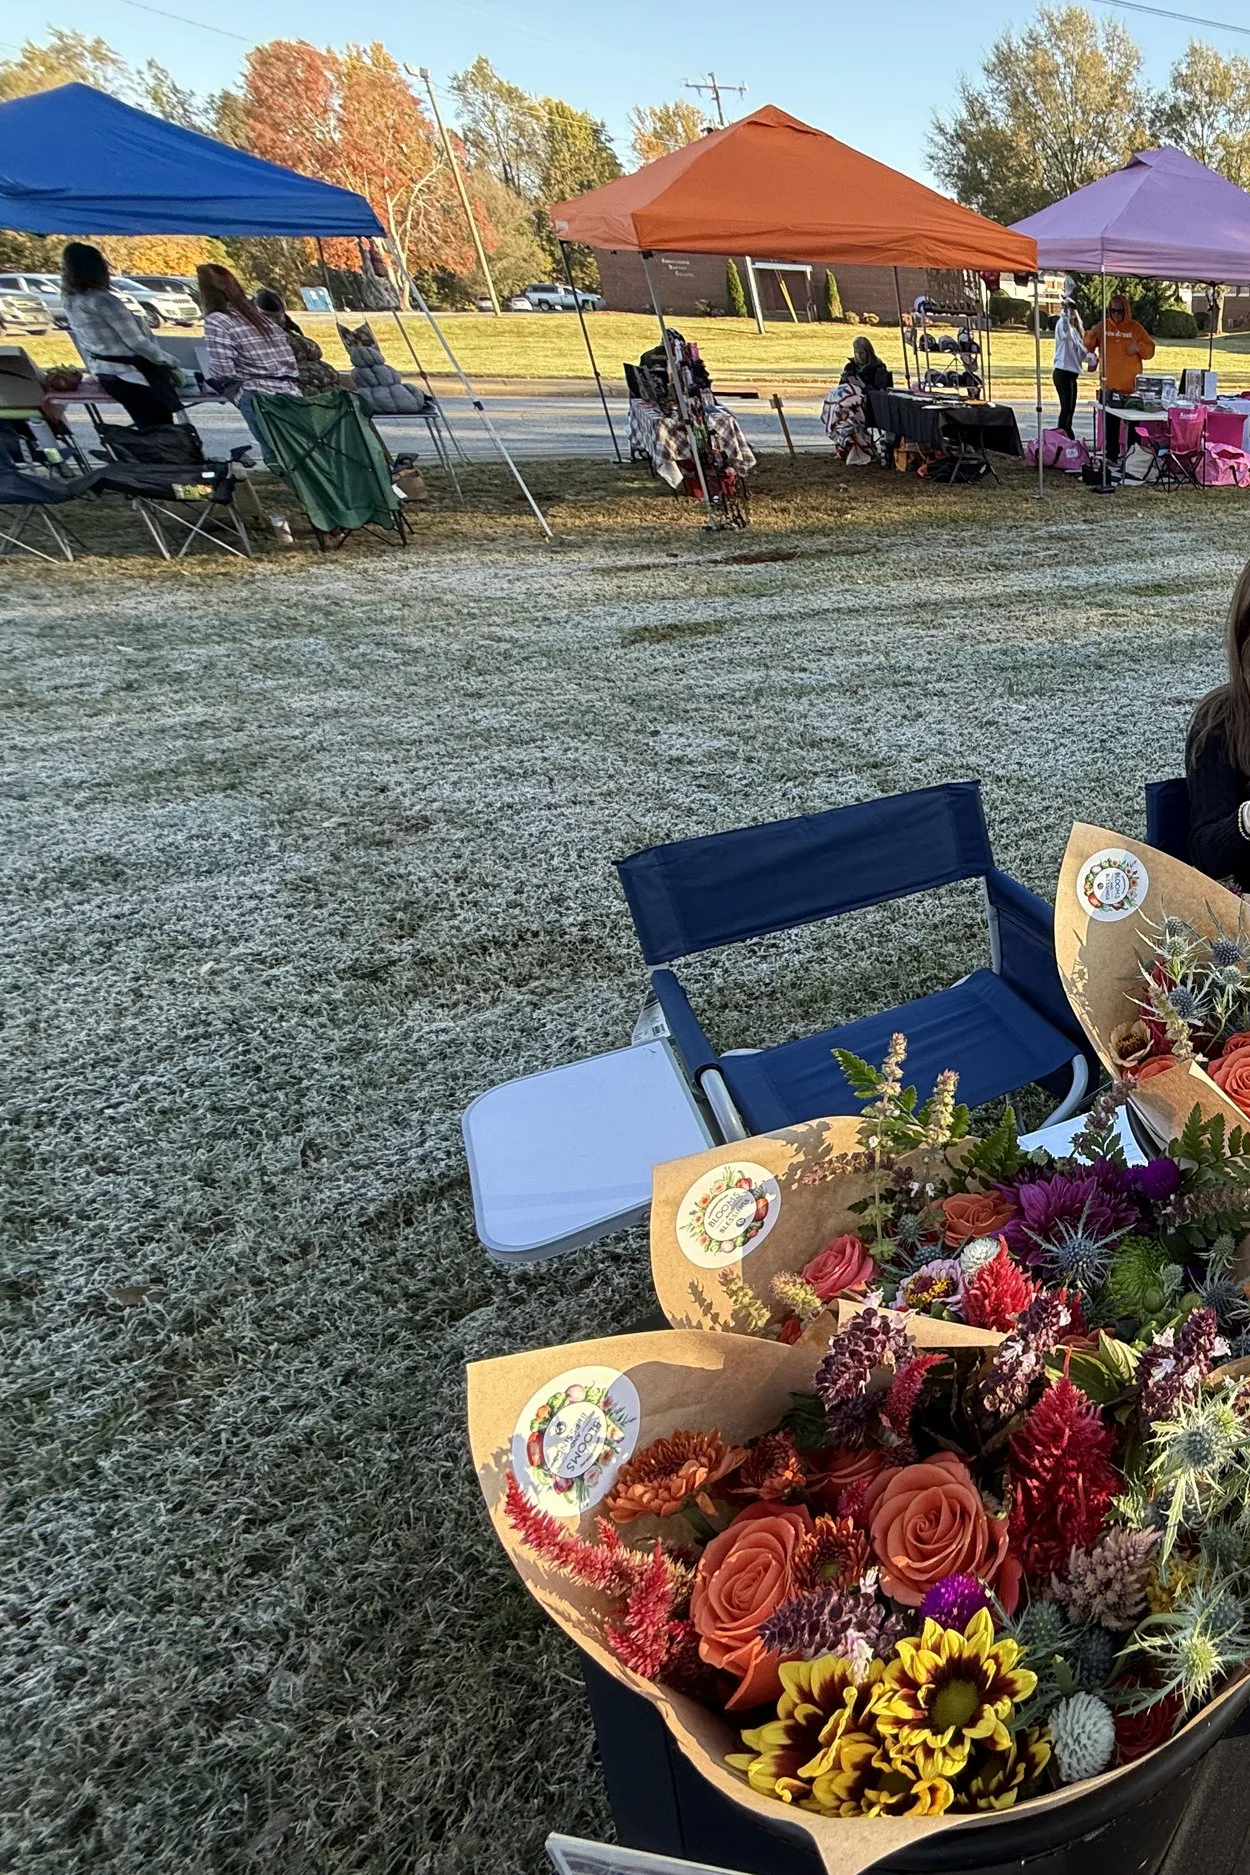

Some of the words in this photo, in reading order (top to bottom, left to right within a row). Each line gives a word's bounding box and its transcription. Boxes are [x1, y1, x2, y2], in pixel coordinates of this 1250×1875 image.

[708, 1191, 741, 1229] BLOOMS
[718, 1198, 752, 1234] BLESSINGS
[566, 1419, 601, 1472] BLOOMS
